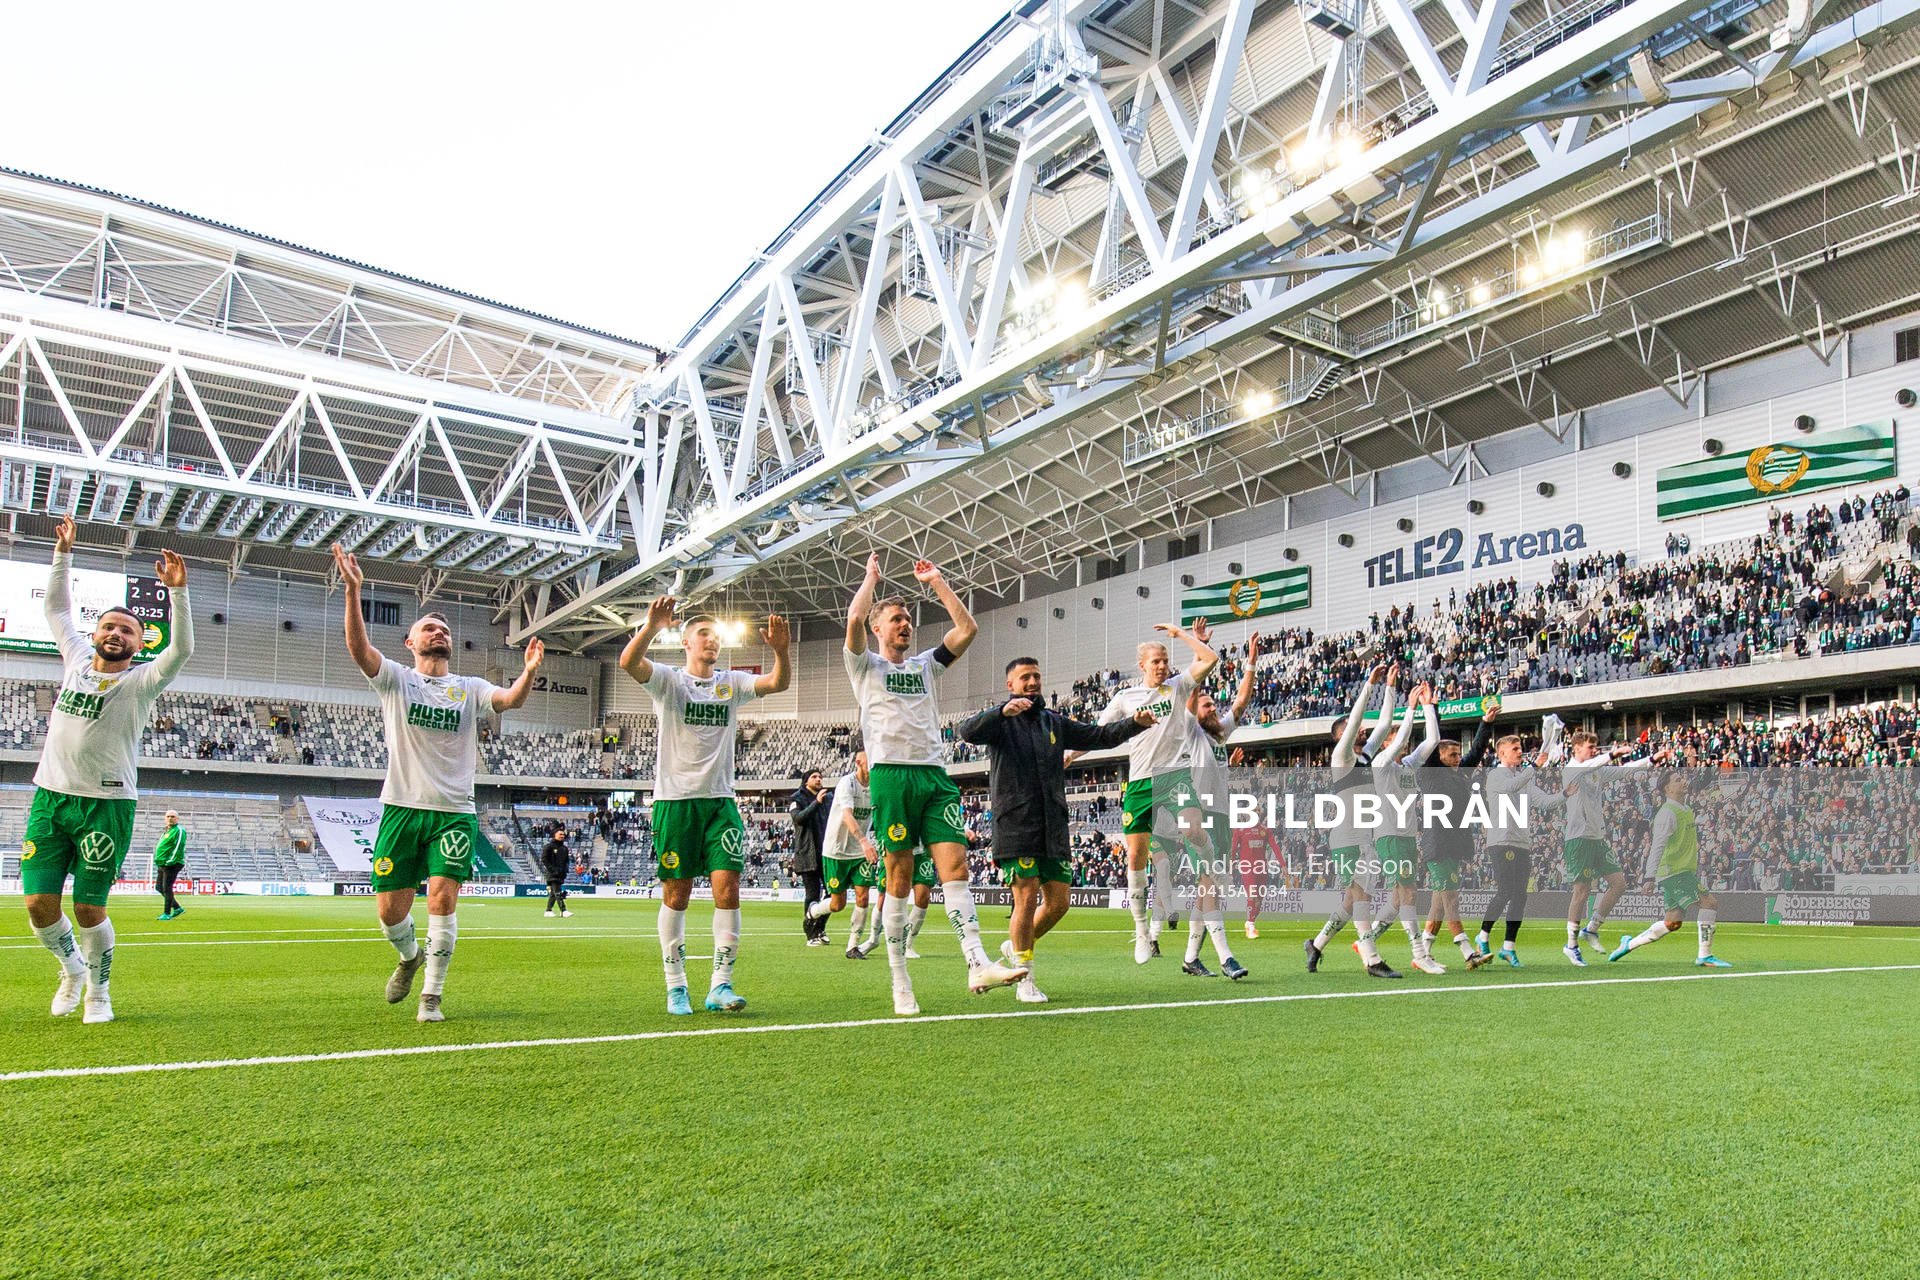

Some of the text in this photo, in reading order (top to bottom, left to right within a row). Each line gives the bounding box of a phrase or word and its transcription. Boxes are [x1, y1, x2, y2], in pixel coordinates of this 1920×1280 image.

[1364, 523, 1587, 588] TELE2 Arena
[131, 586, 140, 598] 2
[156, 589, 165, 601] 0
[132, 606, 164, 618] 93:25
[549, 681, 588, 695] Arena
[885, 673, 925, 688] HUSKI
[60, 687, 105, 713] HUSKI
[409, 702, 461, 724] HUSKI
[685, 702, 729, 720] HUSKI
[407, 717, 460, 732] CHOCOLATE
[684, 717, 729, 727] CHOCOLATE
[261, 883, 307, 894] Flinks
[460, 886, 510, 894] ERSPORT
[1070, 893, 1099, 906] RIAN
[1784, 895, 1871, 910] SÖDERBERGS
[1783, 908, 1871, 920] MATTLEASING AB
[957, 909, 976, 941] Clinton
